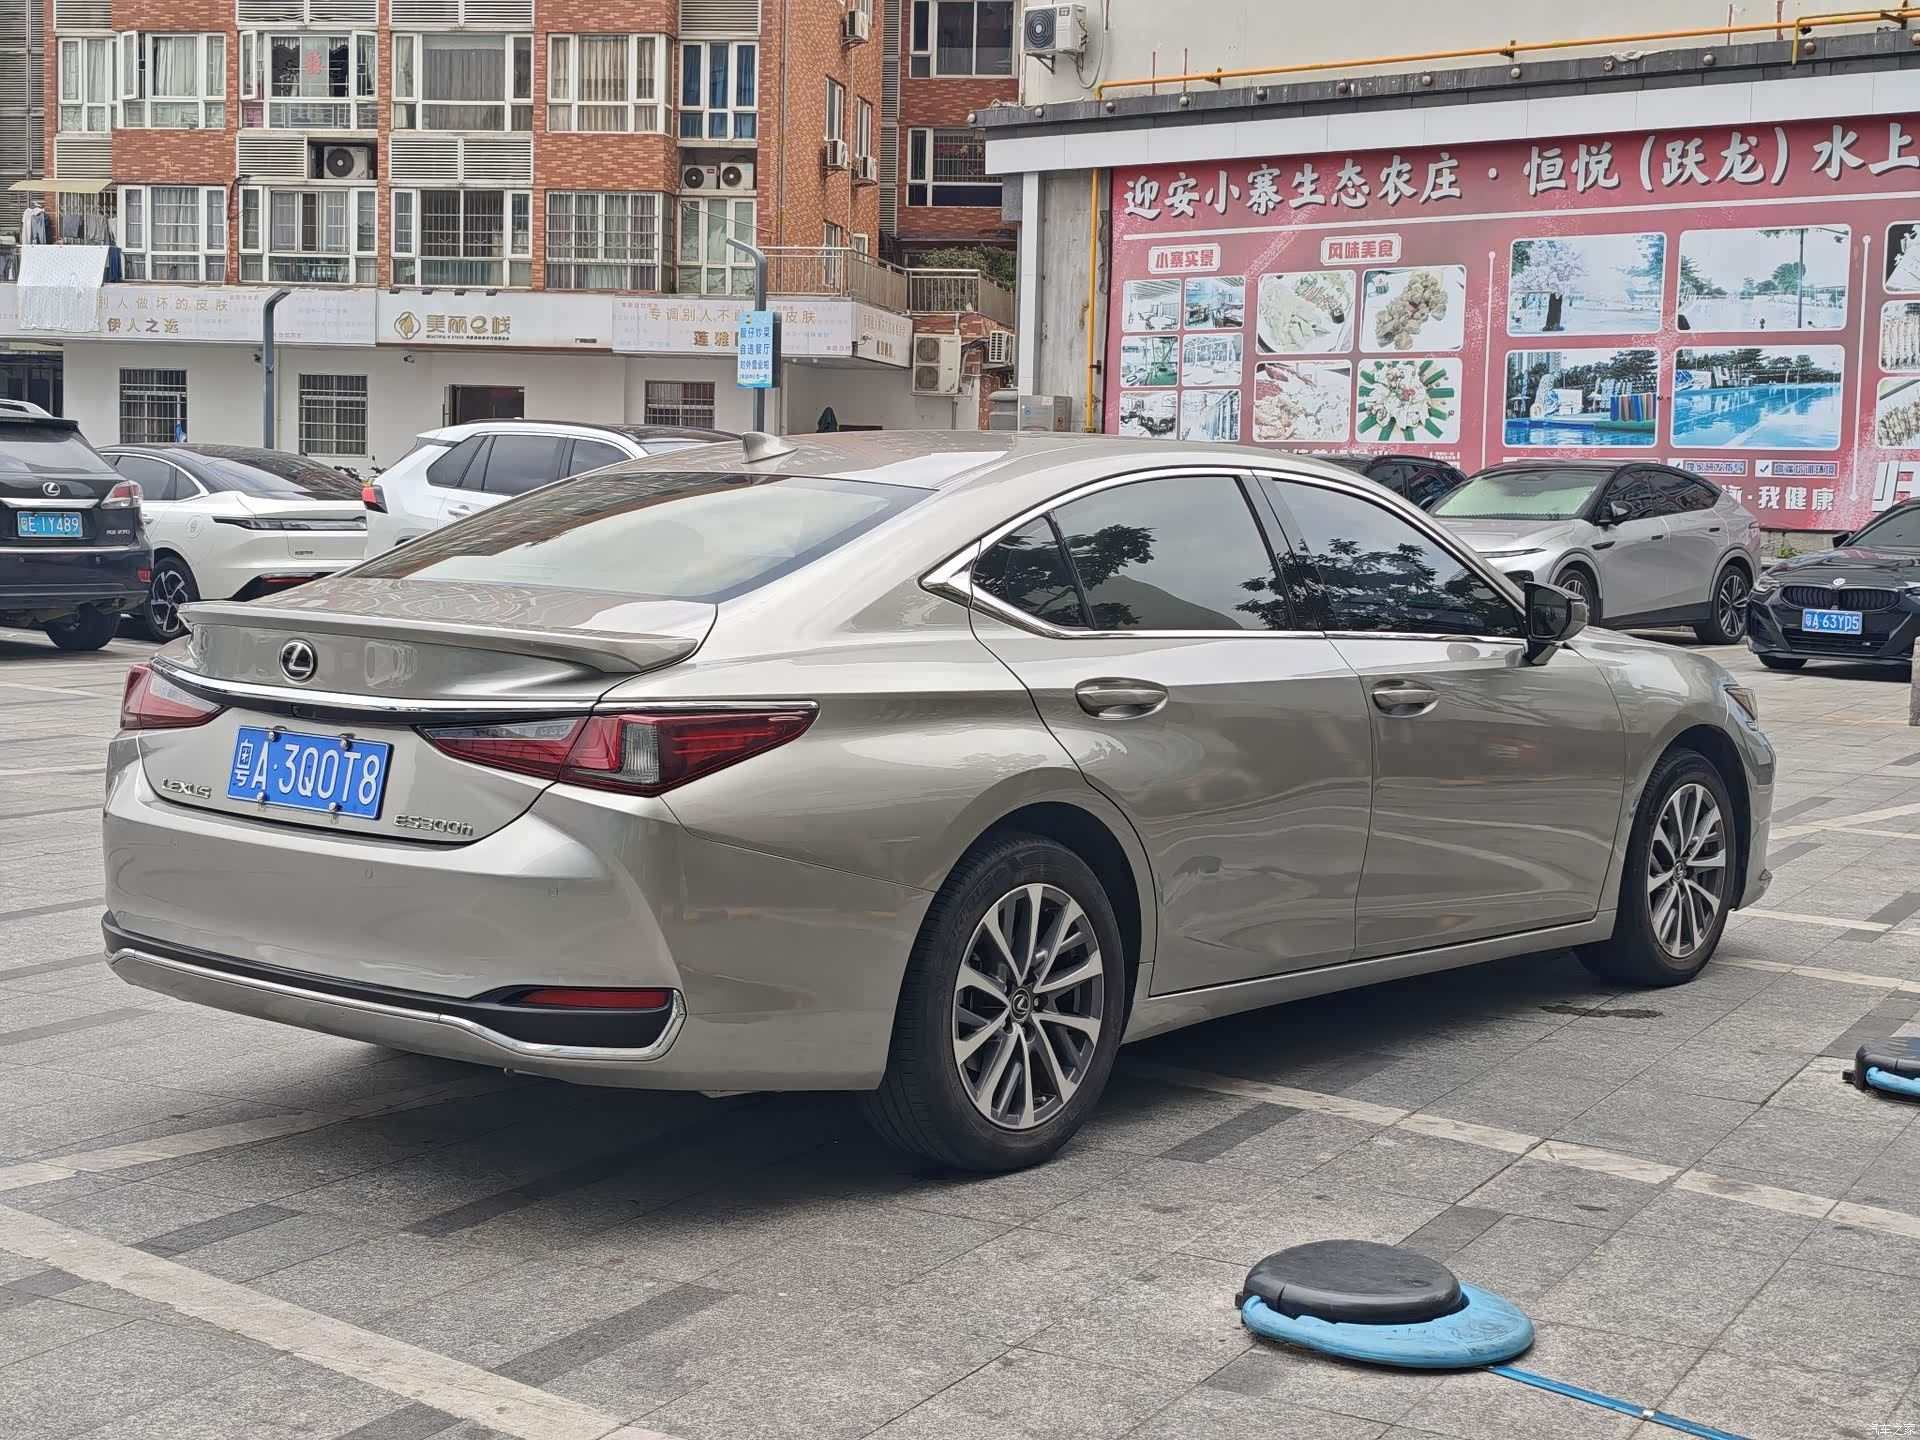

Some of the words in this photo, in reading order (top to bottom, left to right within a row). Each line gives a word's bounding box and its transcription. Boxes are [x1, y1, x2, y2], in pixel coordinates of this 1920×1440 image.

[1155, 248, 1214, 269] 小寨实景
[1327, 239, 1394, 260] 风味美食
[740, 343, 770, 355] 自选餐厅
[161, 777, 212, 799] LEXUS
